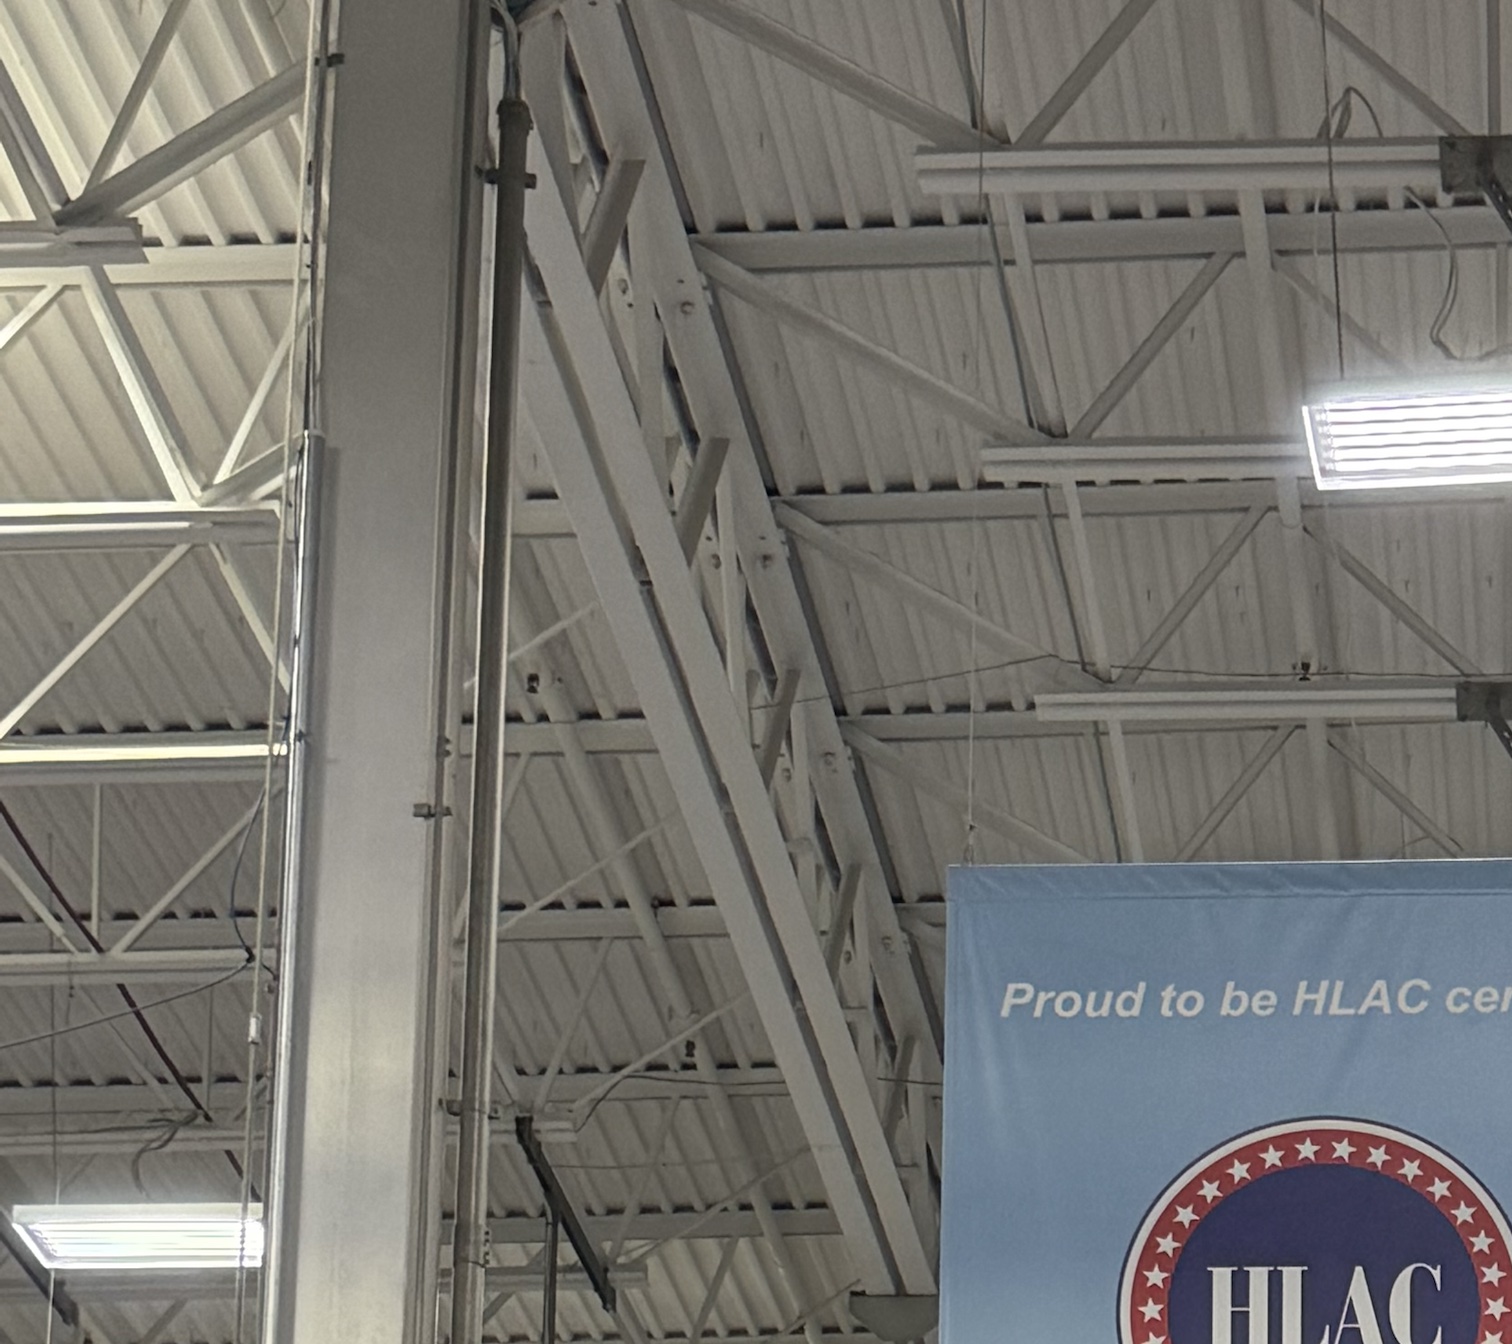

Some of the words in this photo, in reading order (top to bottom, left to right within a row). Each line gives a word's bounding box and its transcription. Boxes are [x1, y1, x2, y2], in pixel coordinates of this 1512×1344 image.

[999, 982, 1146, 1020] Proud
[1159, 984, 1205, 1019] to
[1218, 981, 1278, 1018] be
[1291, 978, 1432, 1017] HLAC
